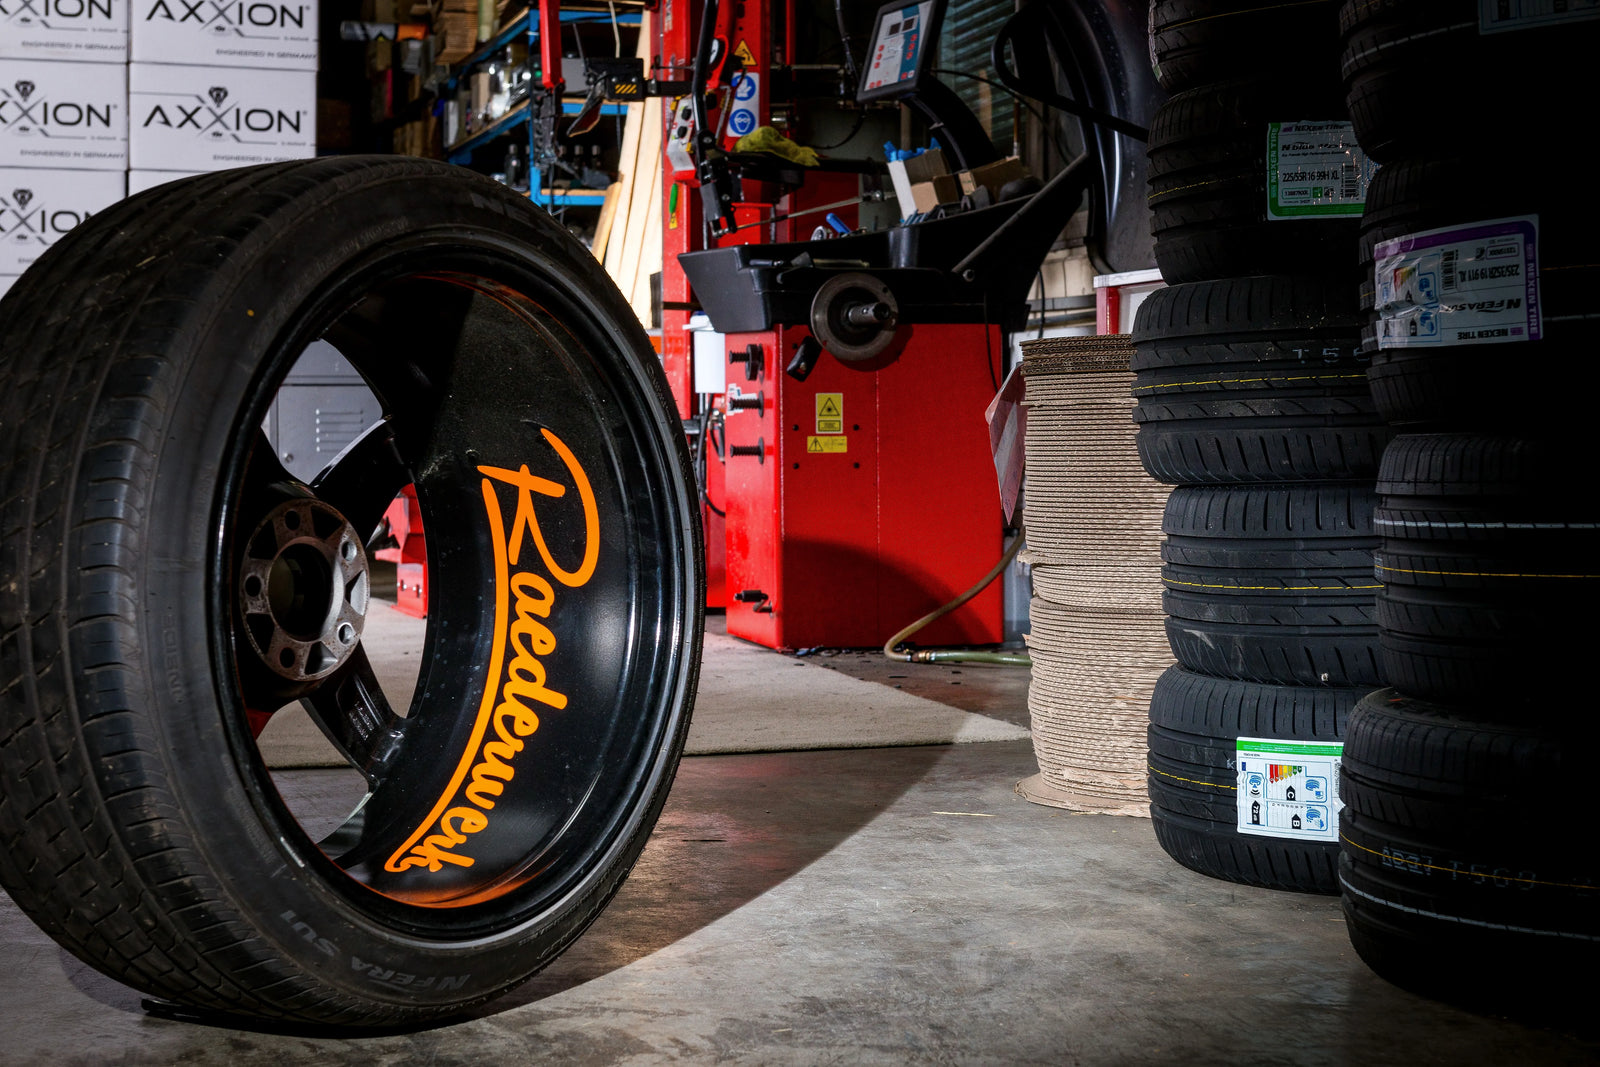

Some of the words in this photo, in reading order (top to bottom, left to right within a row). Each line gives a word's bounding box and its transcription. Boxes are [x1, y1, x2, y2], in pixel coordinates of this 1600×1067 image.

[146, 0, 303, 29] AXXION
[143, 101, 301, 135] AXXION
[1270, 151, 1278, 183] NEXEN
[1331, 170, 1340, 180] XL
[0, 203, 93, 237] XIO
[1527, 262, 1537, 304] NEXEN
[1457, 330, 1477, 340] TIRE
[1478, 327, 1509, 339] NEXEN
[1527, 306, 1538, 335] TIRE
[384, 428, 600, 873] Raederwerk
